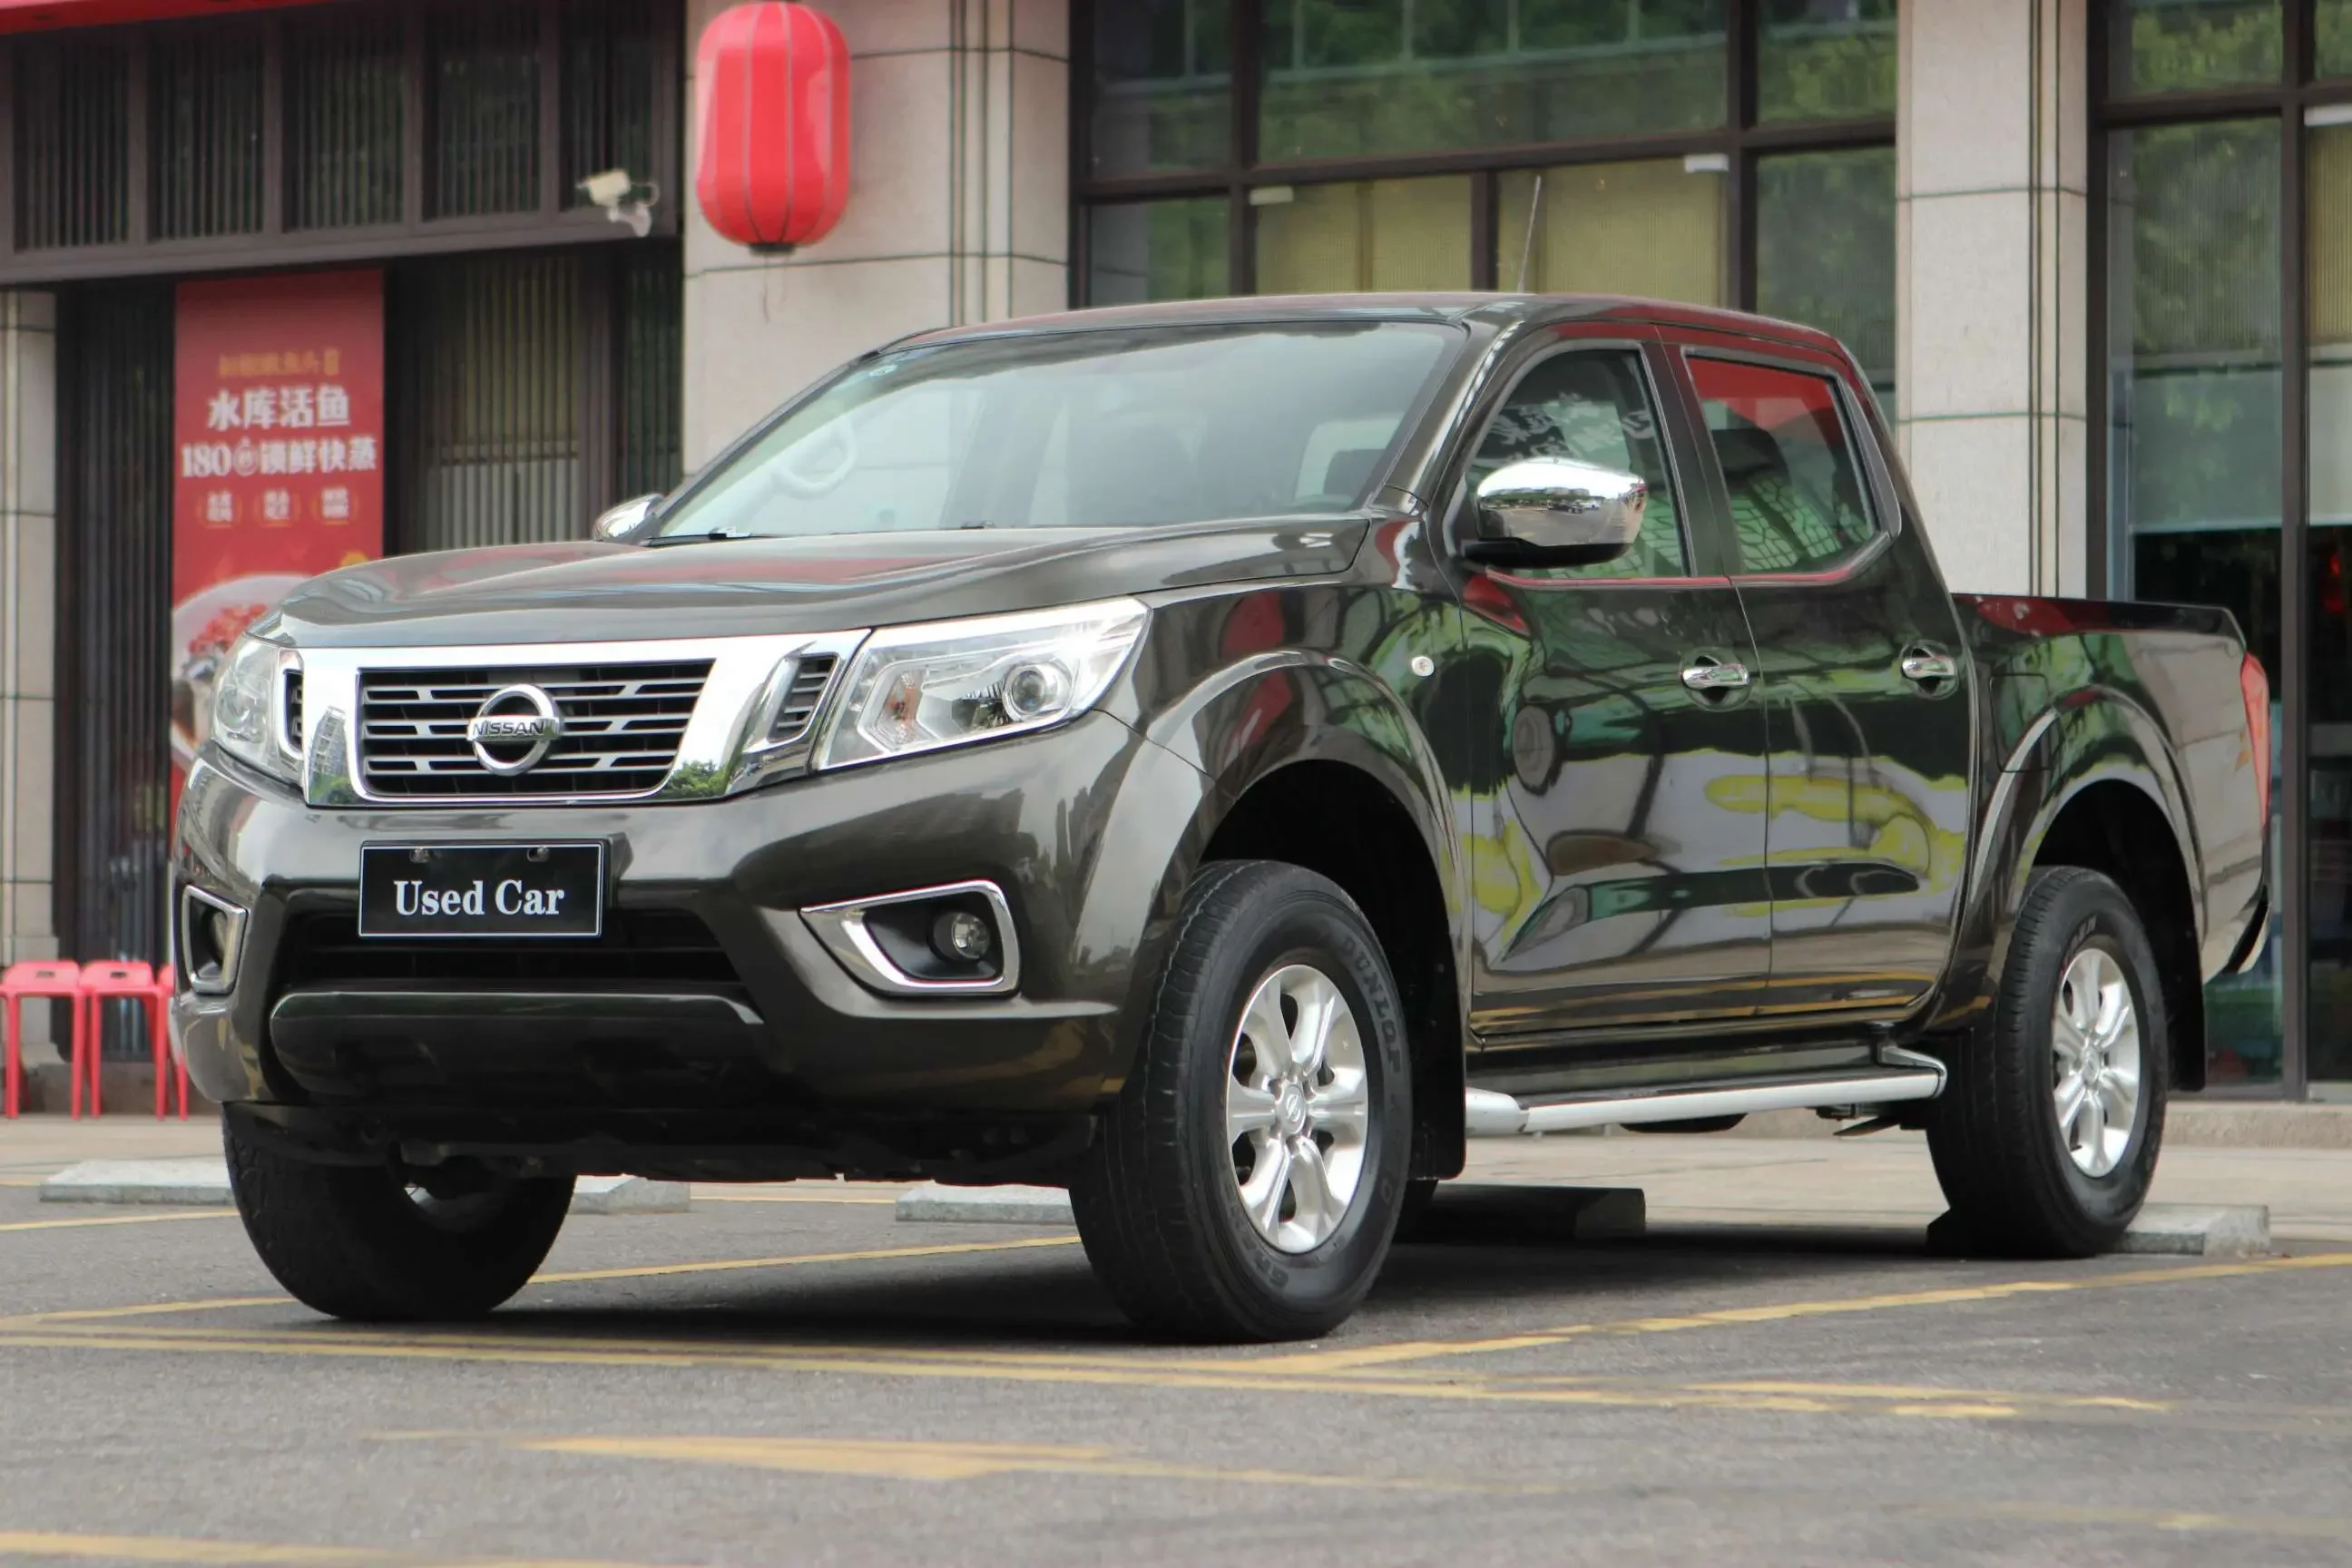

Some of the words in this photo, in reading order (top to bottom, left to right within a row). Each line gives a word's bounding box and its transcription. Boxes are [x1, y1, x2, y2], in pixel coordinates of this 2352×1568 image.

[208, 384, 350, 431] 水库活鱼
[472, 720, 545, 736] NISSAN
[394, 879, 485, 916] Used
[495, 878, 565, 916] Car
[1340, 936, 1402, 1073] DUNLOP
